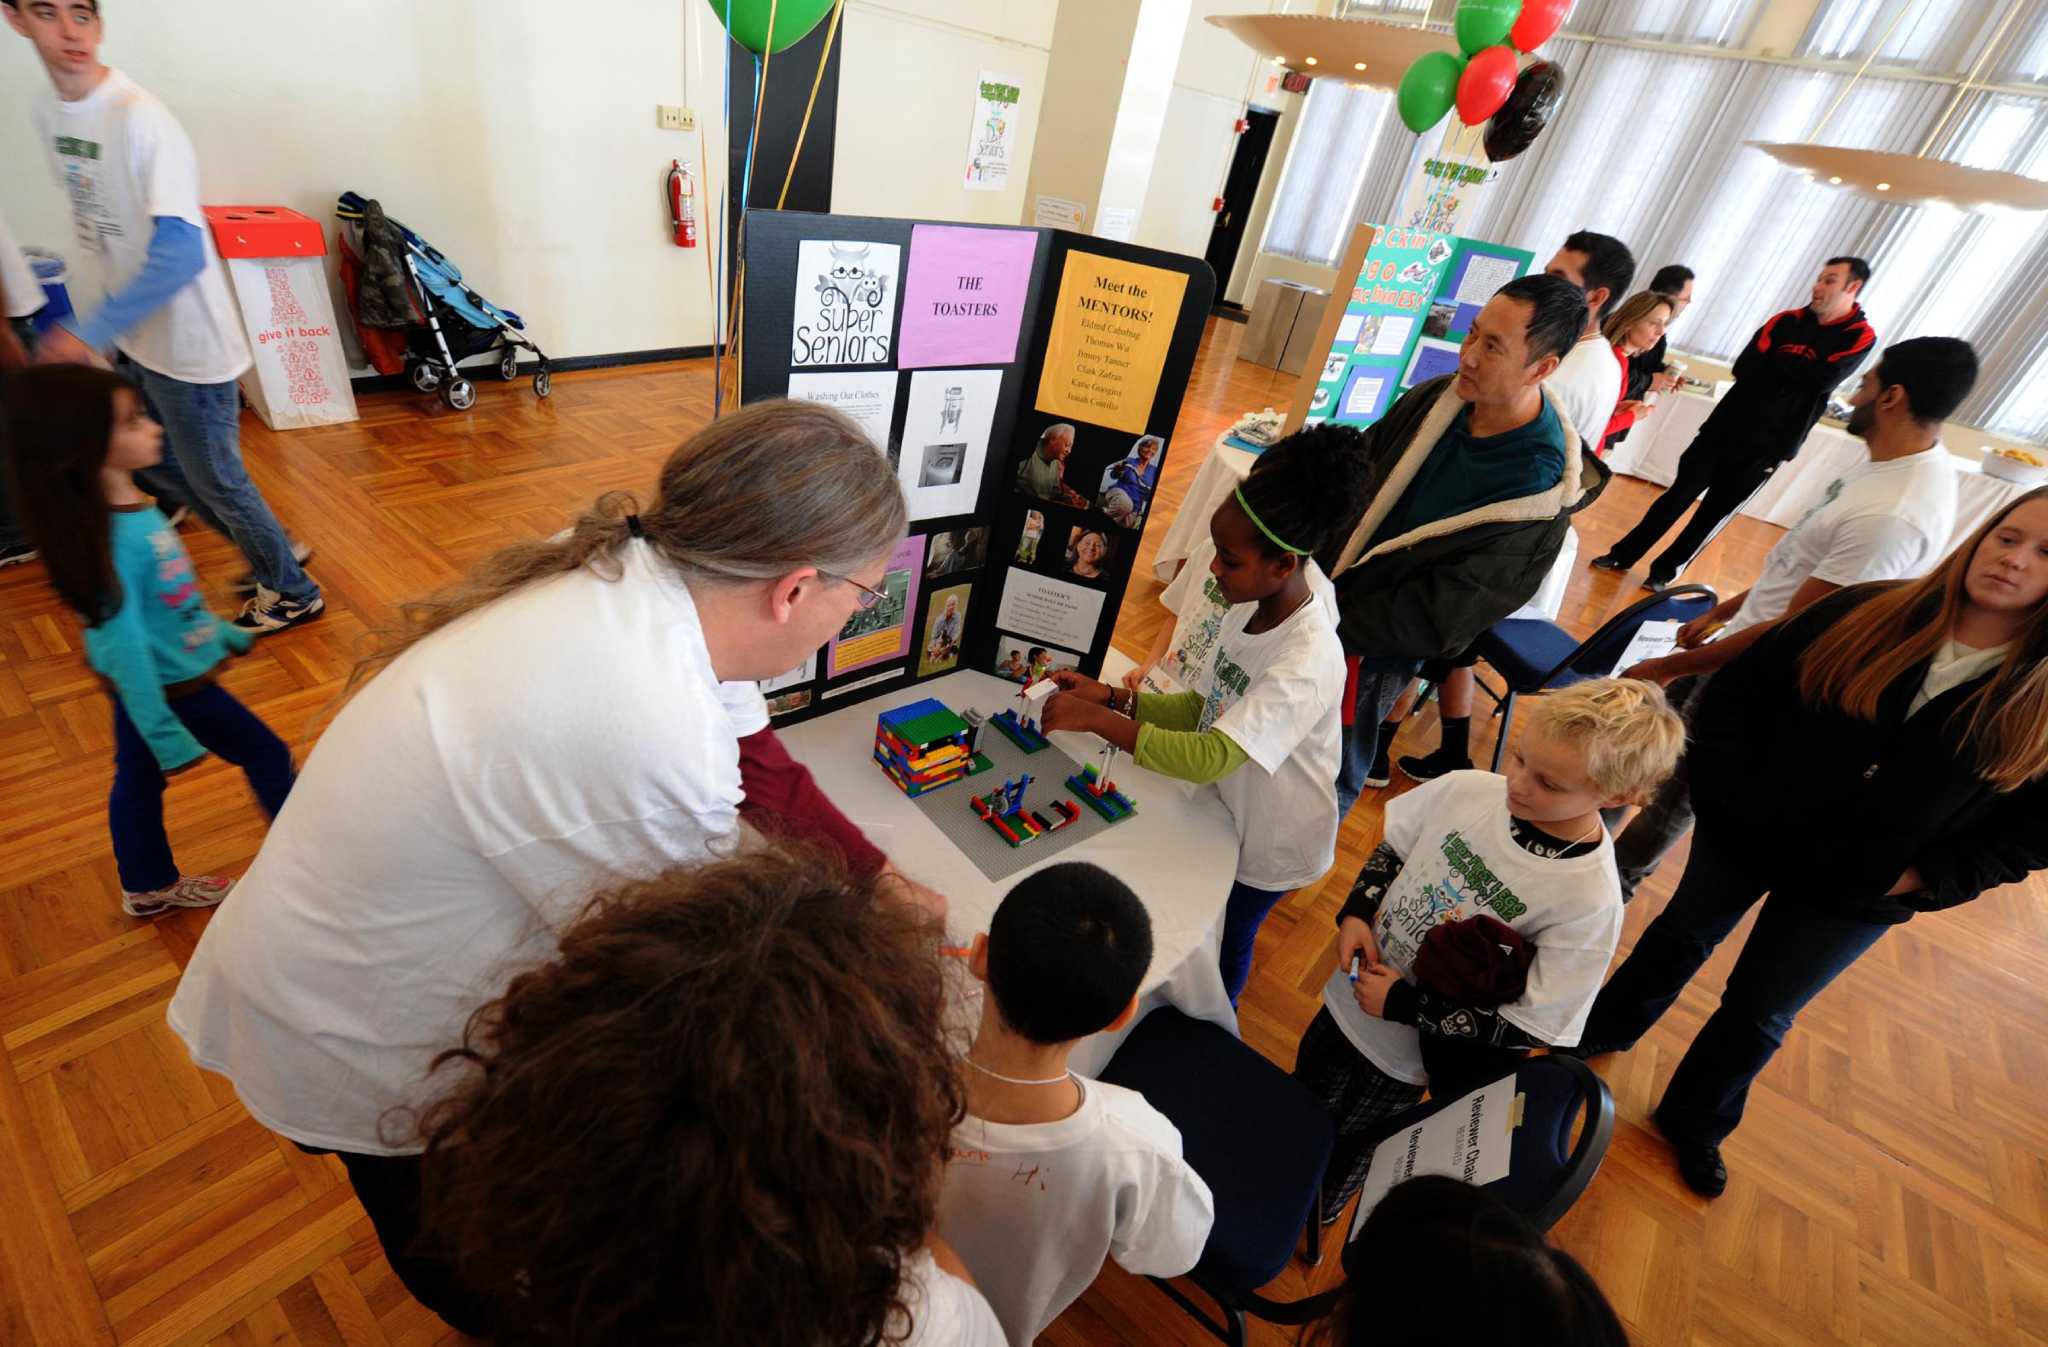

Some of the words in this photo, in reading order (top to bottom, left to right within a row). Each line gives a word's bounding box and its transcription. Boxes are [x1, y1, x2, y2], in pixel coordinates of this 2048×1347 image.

[957, 275, 983, 292] THE
[1094, 276, 1124, 294] Meet
[1128, 284, 1148, 298] the
[932, 301, 998, 316] TOASTERS
[1077, 296, 1153, 324] MENTORS!
[258, 330, 282, 344] give
[285, 327, 295, 337] it
[299, 325, 331, 337] back
[793, 325, 888, 364] Seniors
[808, 391, 839, 402] Washing
[840, 391, 853, 400] Our
[854, 390, 880, 400] Clothes
[1392, 896, 1428, 944] Senio
[1467, 1094, 1485, 1148] Reviewer
[1404, 1127, 1423, 1178] Reviewer
[1463, 1149, 1480, 1181] Chair
